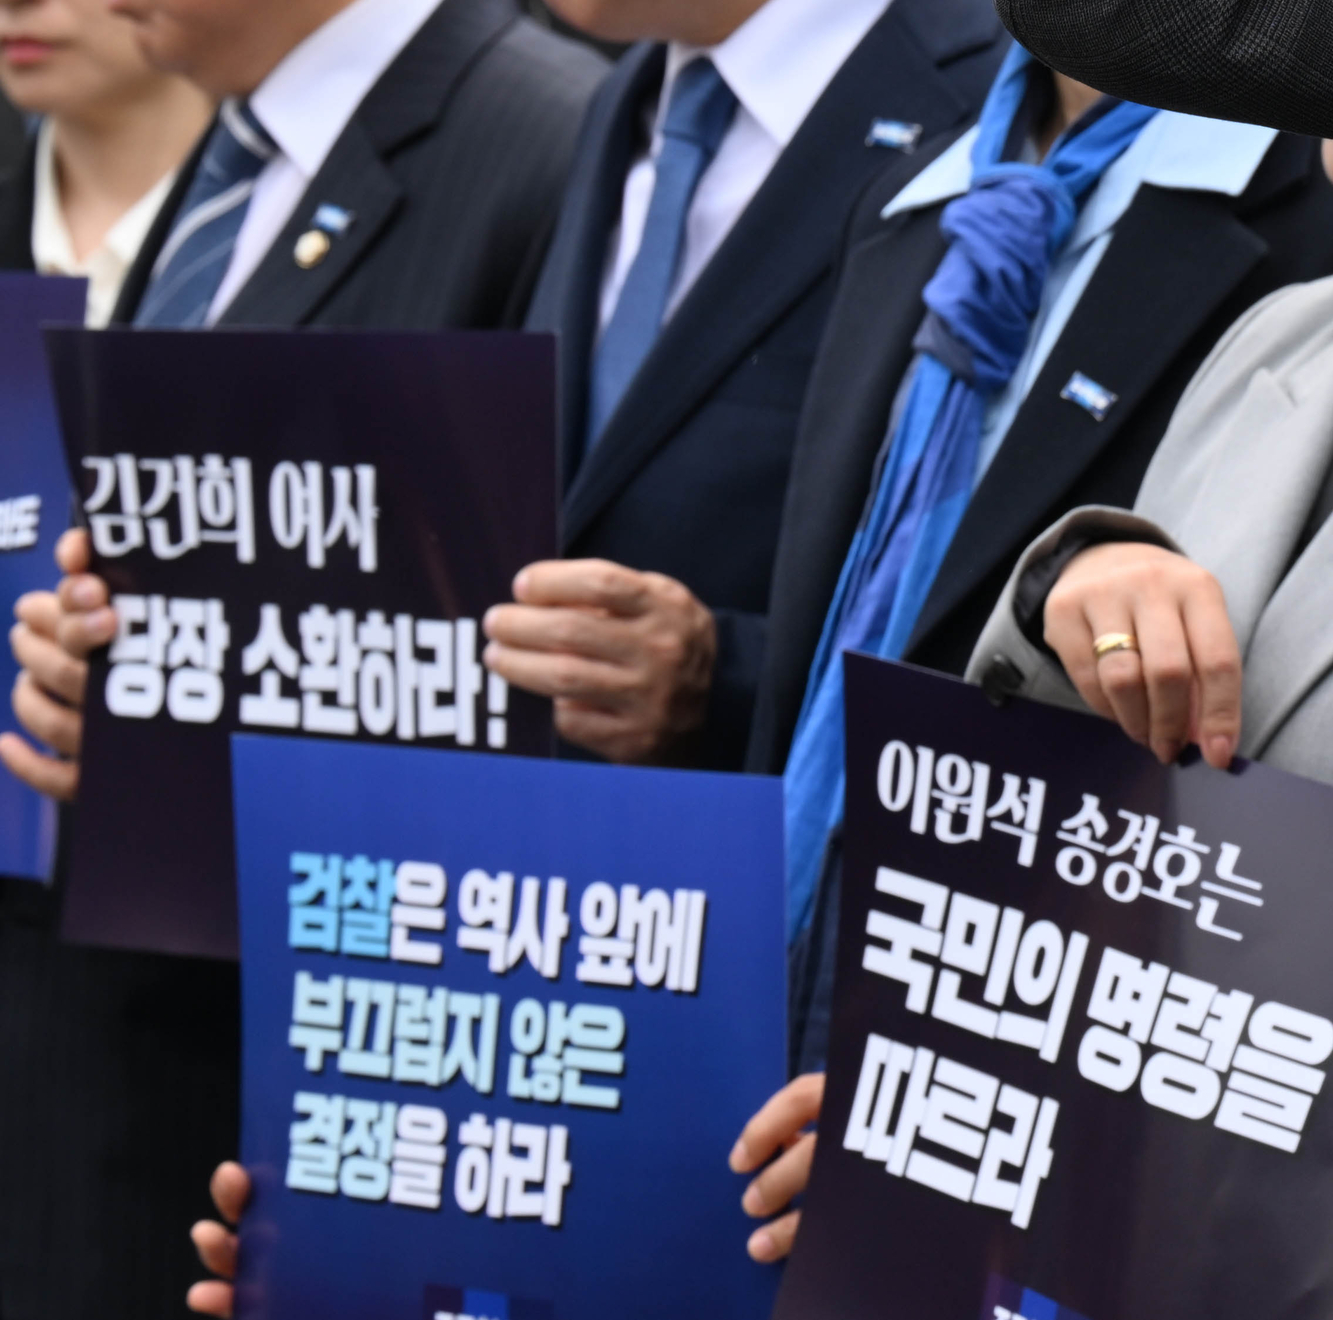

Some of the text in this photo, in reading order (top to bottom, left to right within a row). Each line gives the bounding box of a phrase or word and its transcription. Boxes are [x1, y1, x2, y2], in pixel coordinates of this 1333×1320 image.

[82, 453, 256, 563] 김건희
[269, 461, 380, 571] 여사
[105, 594, 230, 724] 당장
[877, 740, 1263, 942] 이원석 송경호는
[288, 852, 707, 993] 검찰은 역사 앞에
[862, 866, 1089, 1064] 국민의
[288, 970, 626, 1108] 부끄럽지 않은
[286, 1091, 572, 1226] 결정을 하라
[842, 1033, 1060, 1230] 따르라
